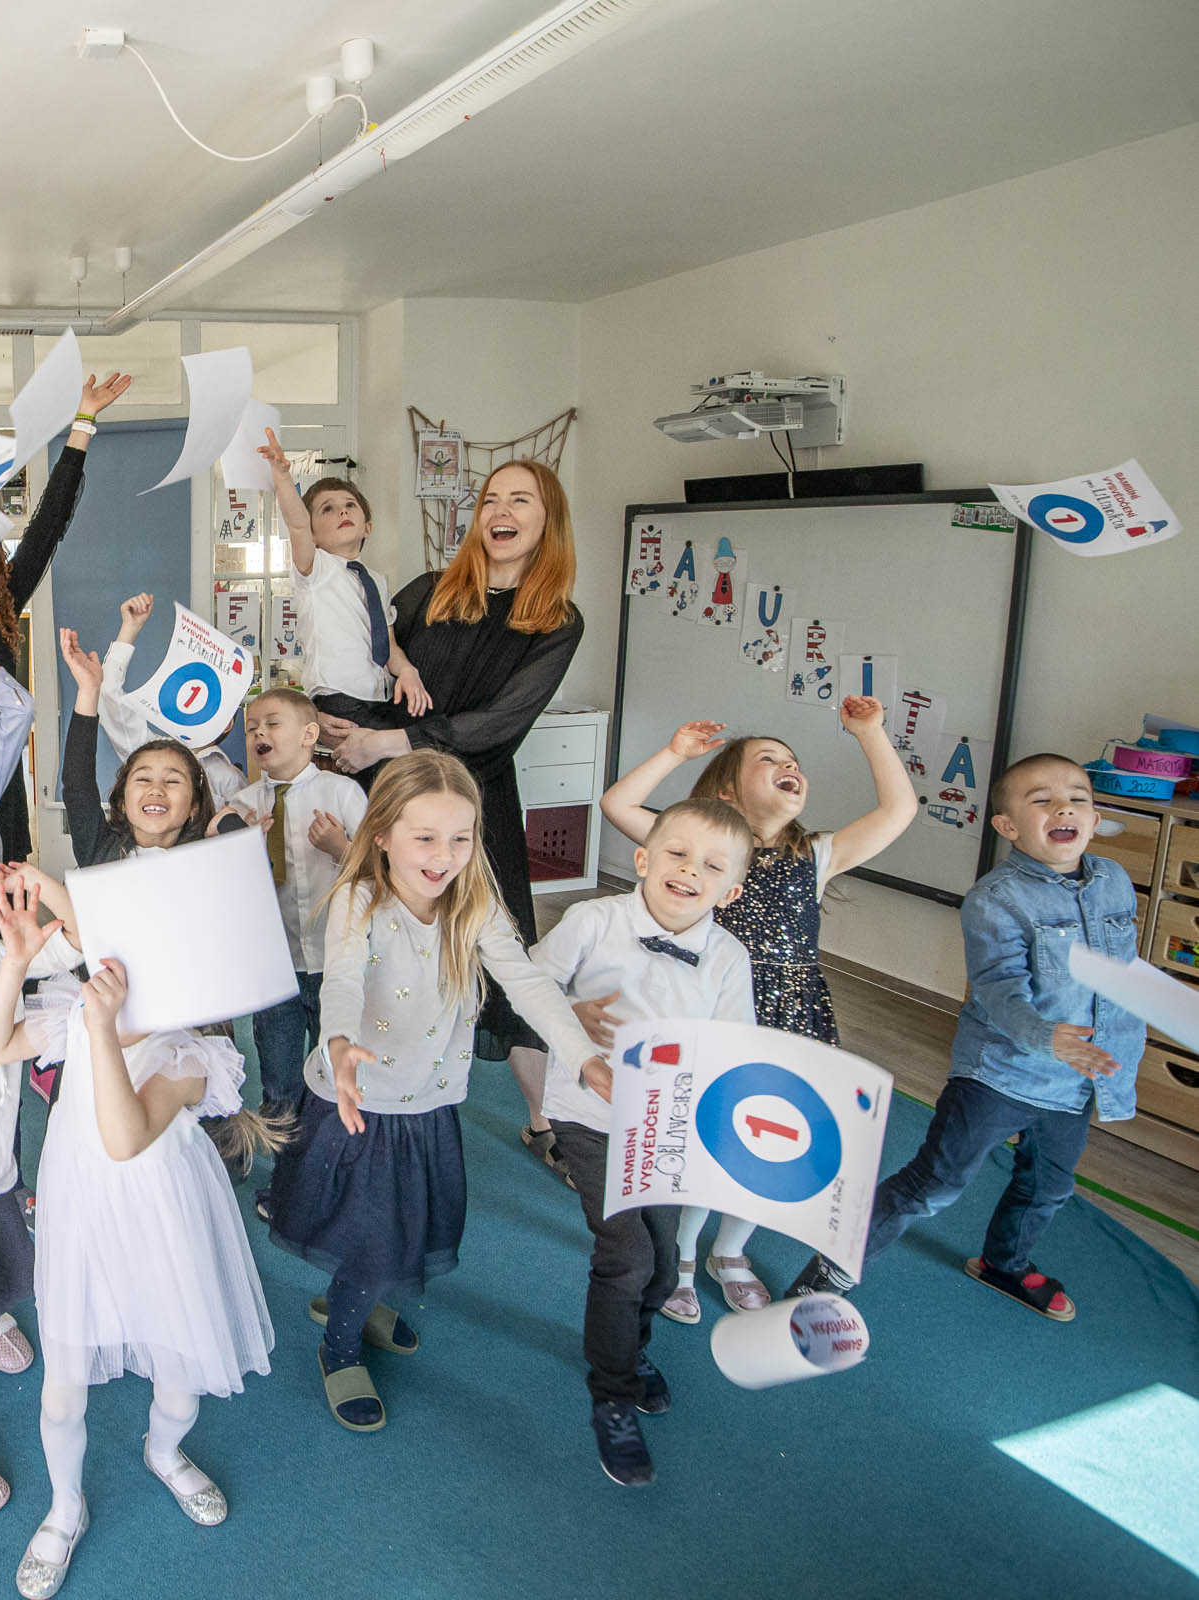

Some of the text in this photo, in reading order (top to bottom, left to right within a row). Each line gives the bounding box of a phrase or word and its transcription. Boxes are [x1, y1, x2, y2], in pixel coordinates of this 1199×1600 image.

[1051, 513, 1078, 524] 1
[229, 596, 249, 625] F
[640, 528, 662, 561] M
[673, 546, 696, 582] A
[758, 590, 783, 628] U
[806, 625, 827, 663] R
[903, 691, 932, 735] T
[941, 743, 976, 788] A
[183, 684, 202, 709] 1
[1127, 779, 1157, 794] 2022
[639, 1088, 662, 1193] VYSVĚDČENÍ
[745, 1113, 800, 1142] 1
